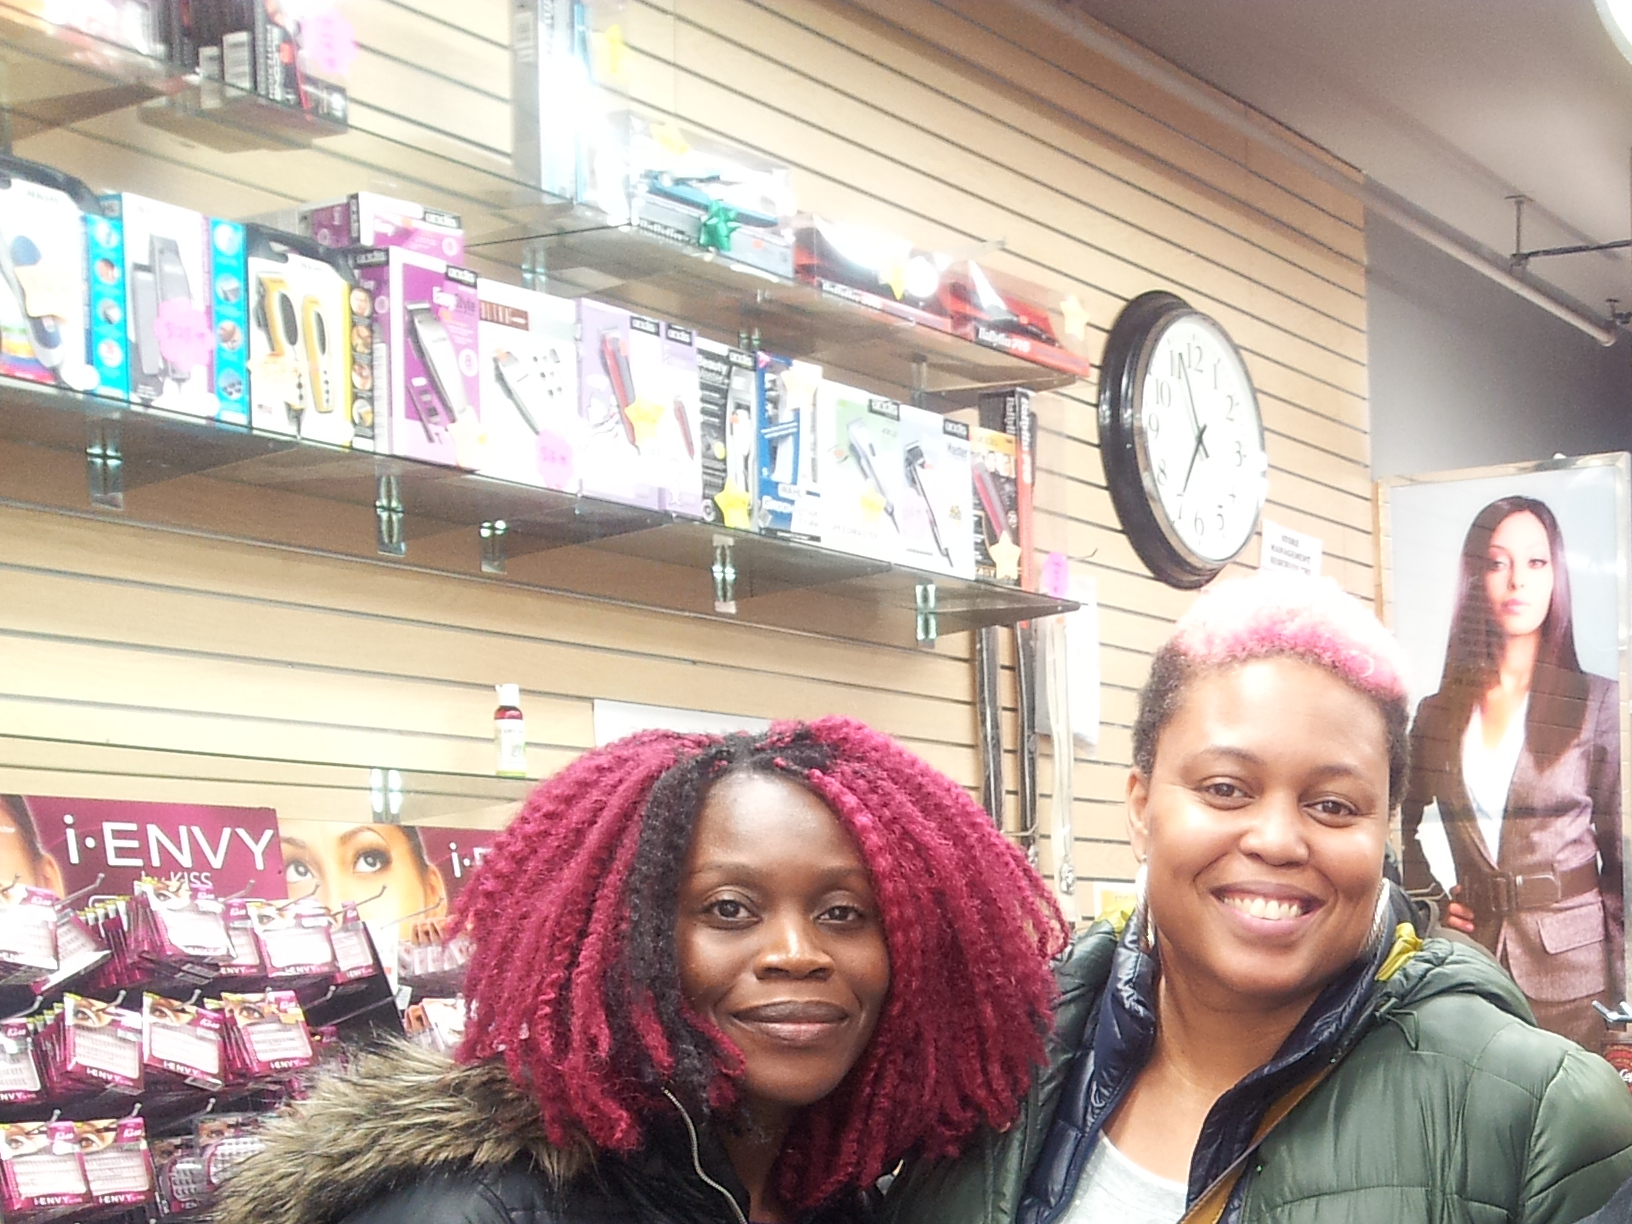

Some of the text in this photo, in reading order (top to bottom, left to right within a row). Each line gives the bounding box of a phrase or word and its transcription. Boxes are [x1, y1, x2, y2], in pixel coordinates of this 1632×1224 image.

[1187, 342, 1204, 373] 12
[1156, 377, 1172, 409] 10
[1148, 412, 1160, 441] 9
[1157, 458, 1168, 487] 8
[1194, 509, 1206, 537] 6
[170, 870, 214, 890] KISS
